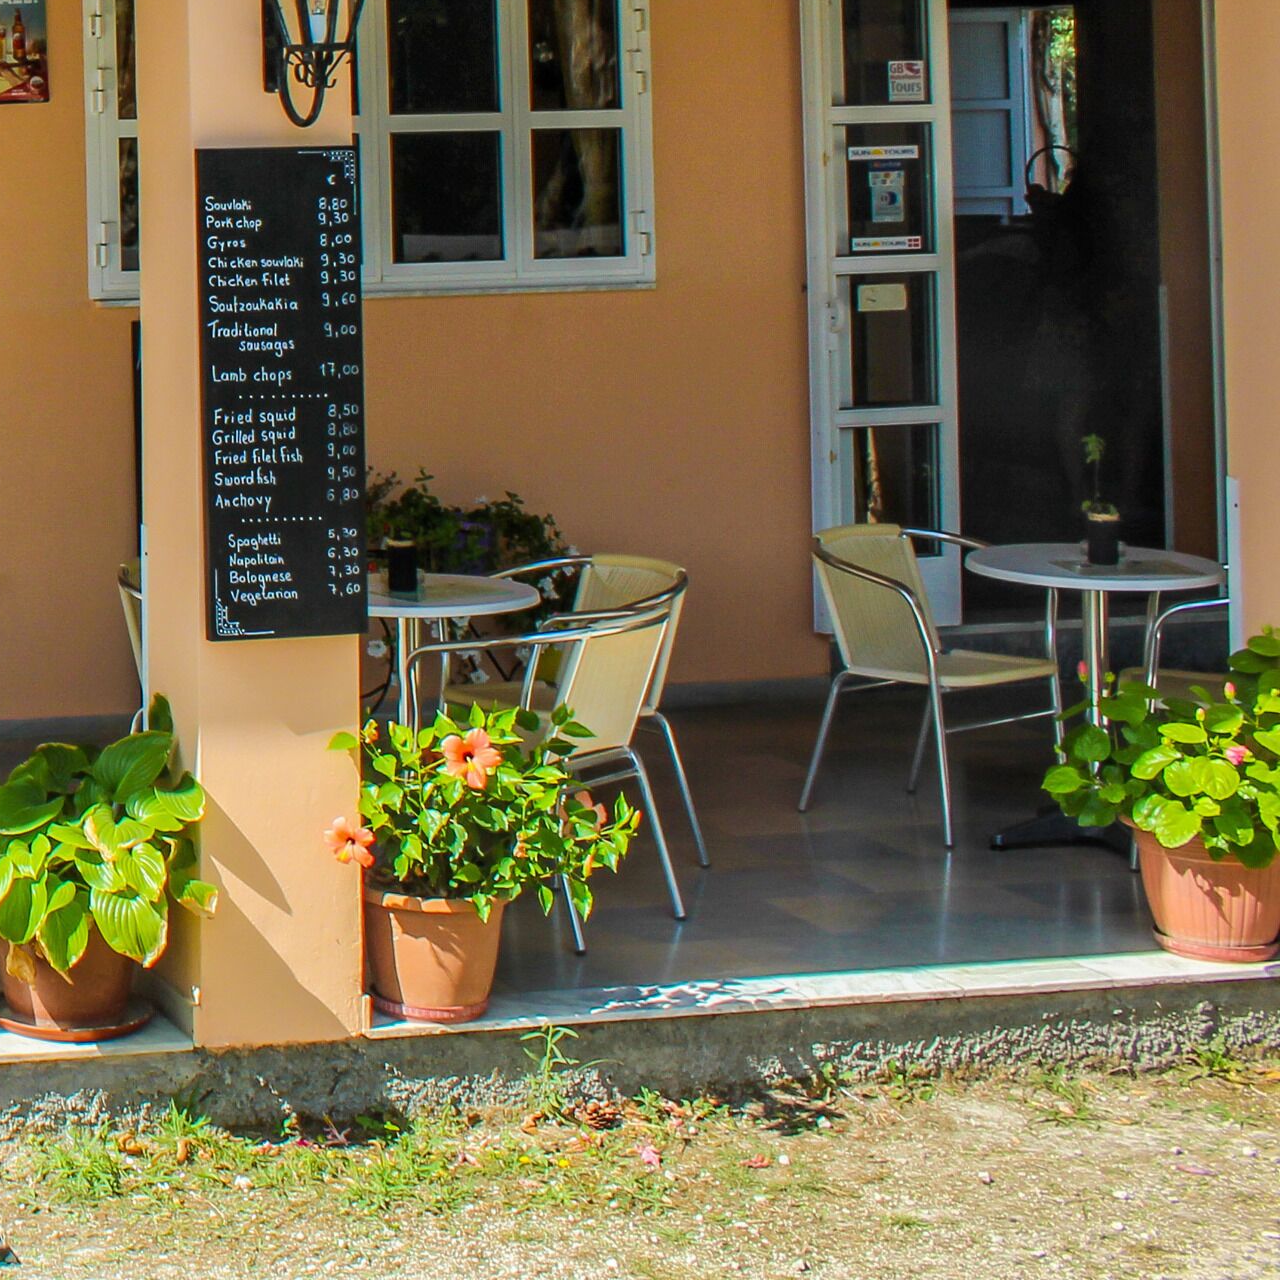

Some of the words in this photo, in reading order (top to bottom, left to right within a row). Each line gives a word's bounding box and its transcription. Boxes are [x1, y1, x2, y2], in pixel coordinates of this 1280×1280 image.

[205, 196, 252, 212] Souvlaki
[318, 196, 348, 212] 8,80
[206, 215, 234, 228] Pork
[236, 216, 262, 232] chop
[318, 212, 349, 227] 9,30
[207, 236, 246, 252] Gyros
[320, 233, 352, 248] 8,00
[208, 256, 258, 268] Chicken
[260, 256, 304, 268] souvlaki
[320, 252, 356, 268] 9,30
[208, 273, 258, 287] Chicken
[320, 270, 356, 284] 9,30
[209, 295, 298, 313] Soutzoukakia
[322, 292, 356, 308] 9,60
[207, 319, 278, 338] Traditional
[324, 322, 357, 338] 9,00
[238, 340, 295, 358] sausages
[212, 364, 247, 382] Lamb
[253, 366, 292, 387] chops
[320, 362, 360, 379] 17,00
[214, 408, 252, 425] Fried
[260, 406, 296, 428] squid
[328, 403, 359, 420] 8,50
[212, 428, 255, 446] Grilled
[261, 426, 296, 446] squid
[328, 422, 358, 438] 8,80
[214, 450, 248, 465] Fried
[280, 446, 304, 464] fish
[328, 442, 356, 460] 9,00
[328, 466, 356, 482] 9,50
[215, 492, 272, 512] Anchovy
[228, 532, 282, 552] Spaghetti
[328, 528, 358, 541] 5,30
[328, 546, 359, 560] 6,30
[229, 570, 293, 588] Bolognese
[328, 564, 360, 578] 7,30
[230, 587, 298, 606] Vegetarian
[328, 582, 360, 597] 7,60
